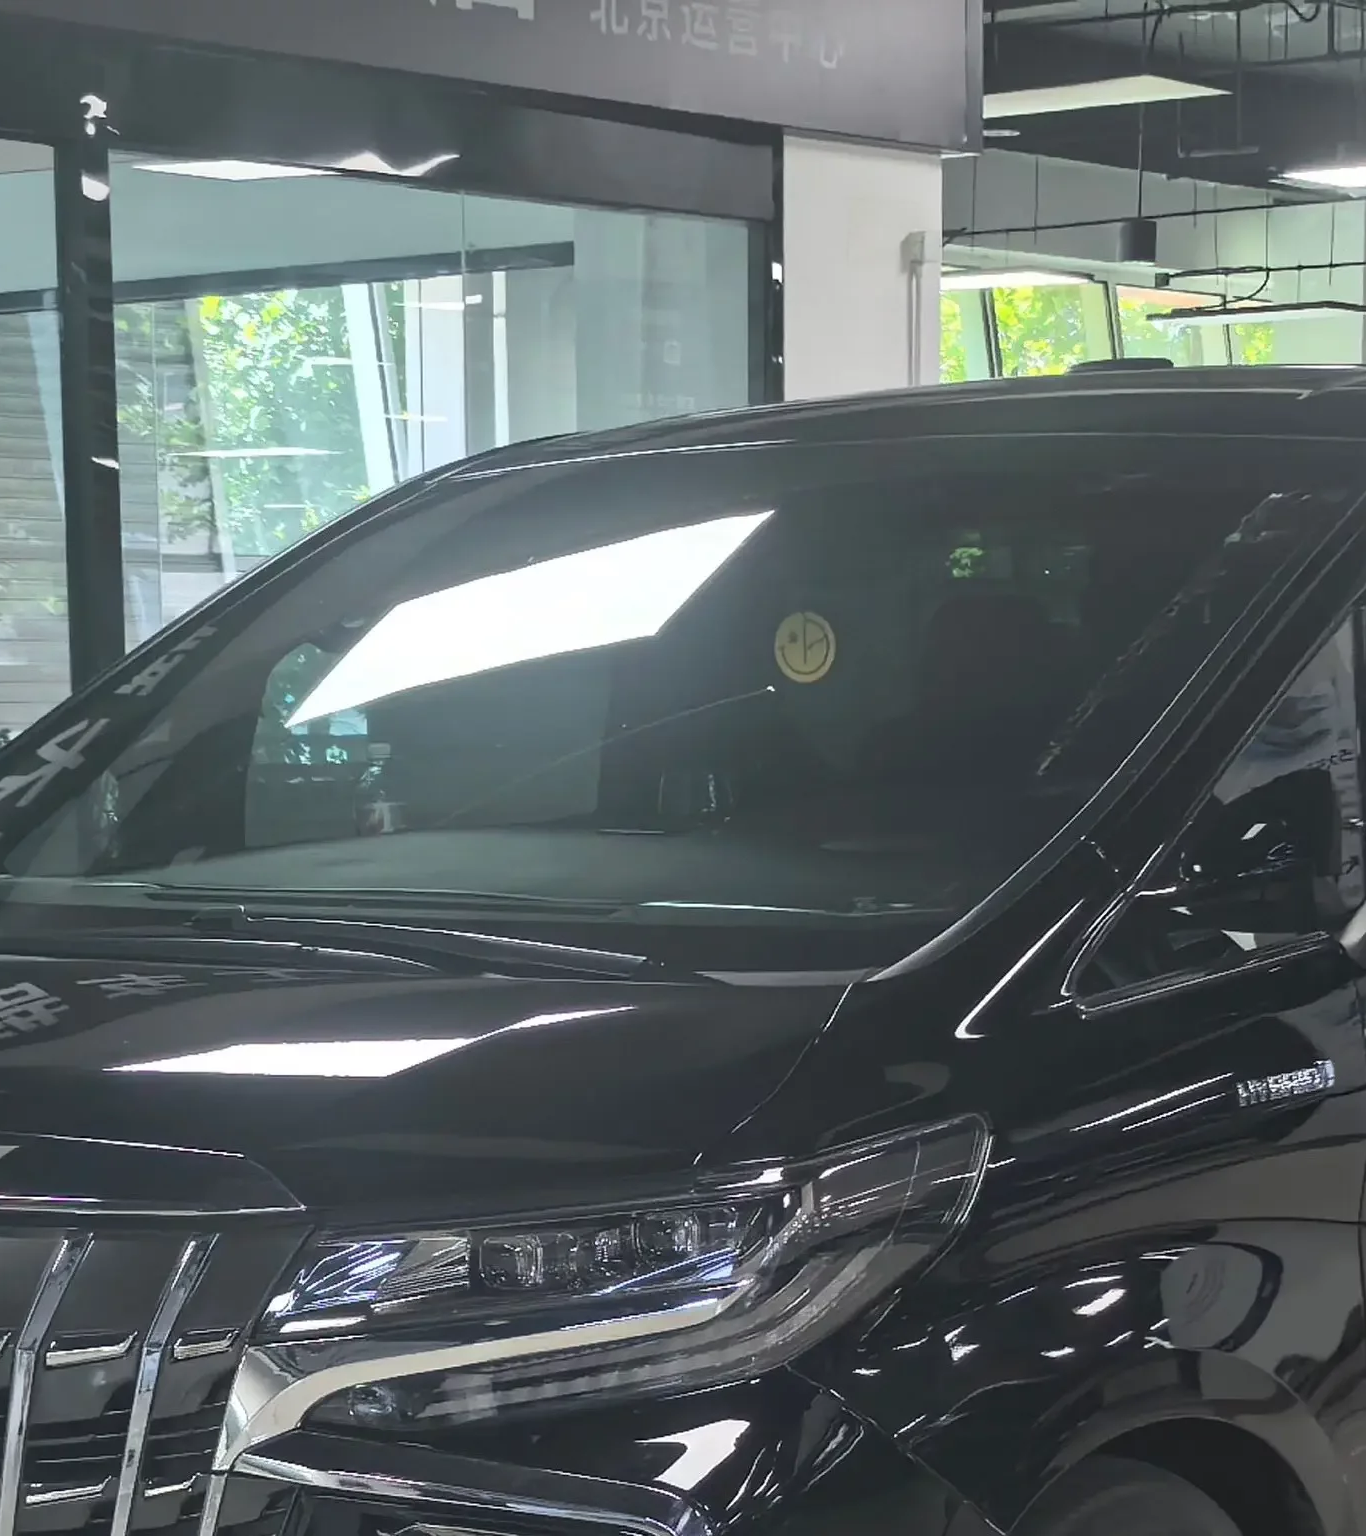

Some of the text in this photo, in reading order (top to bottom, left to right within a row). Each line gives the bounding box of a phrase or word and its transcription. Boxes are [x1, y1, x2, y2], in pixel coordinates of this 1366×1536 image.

[590, 0, 845, 70] 北京运营中心
